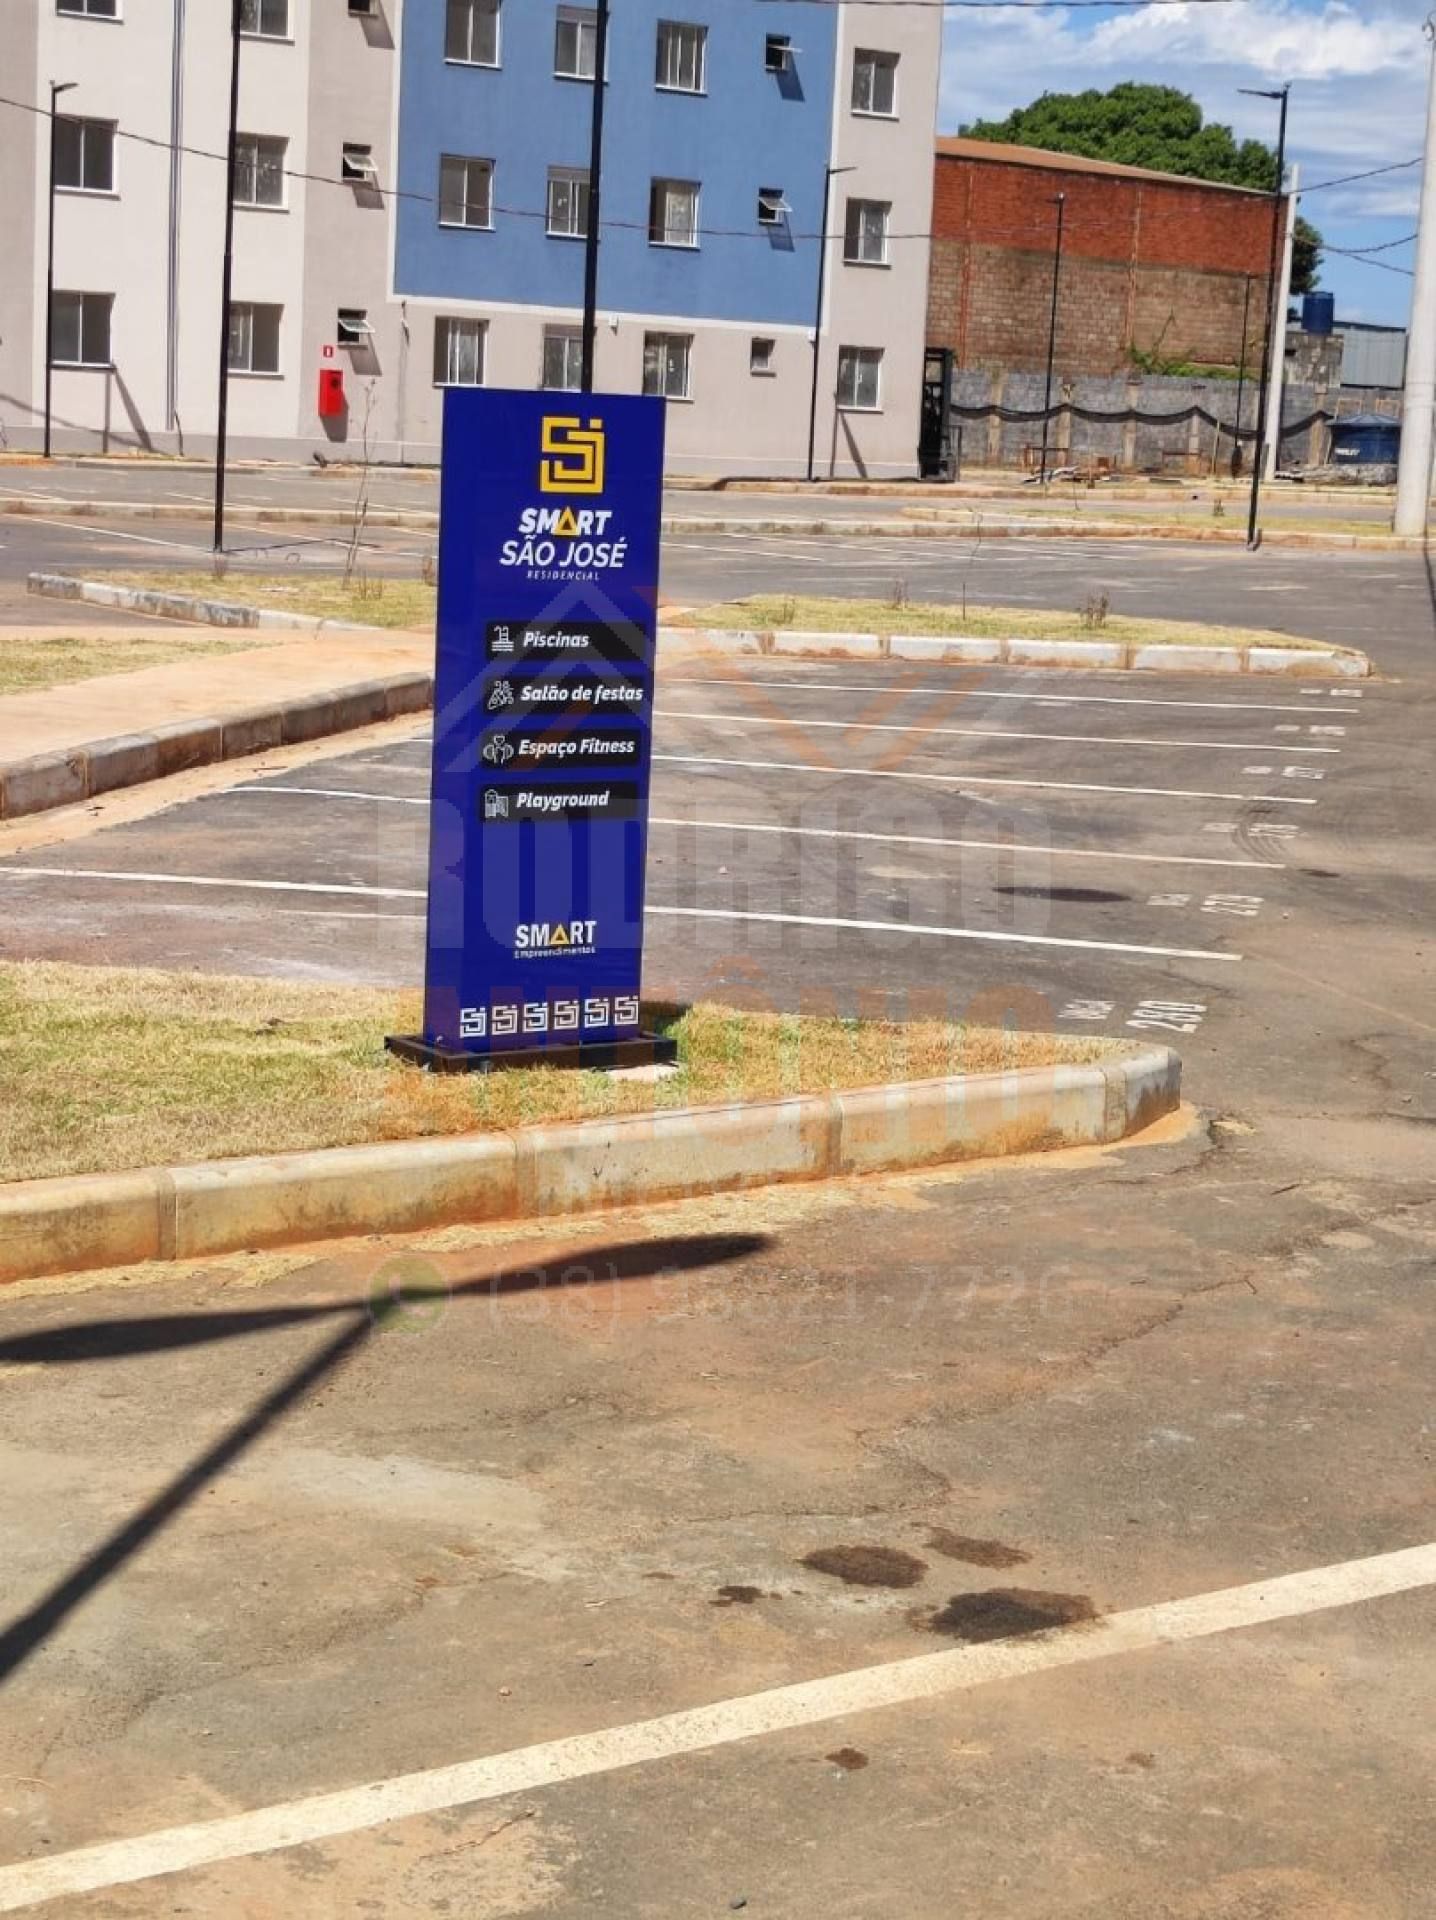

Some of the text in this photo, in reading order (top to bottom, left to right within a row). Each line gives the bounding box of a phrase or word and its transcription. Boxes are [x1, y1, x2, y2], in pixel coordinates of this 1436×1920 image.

[518, 506, 612, 536] SMART
[499, 534, 628, 568] SÃO JOSÉ
[526, 570, 600, 581] RESIDENCIAL
[522, 630, 590, 648] Piscinas
[520, 684, 644, 704] Salão de festas
[518, 737, 635, 758] Espaço Fitness
[515, 789, 611, 811] Playground
[514, 920, 597, 948] SMART
[514, 946, 596, 959] Empreendimentos
